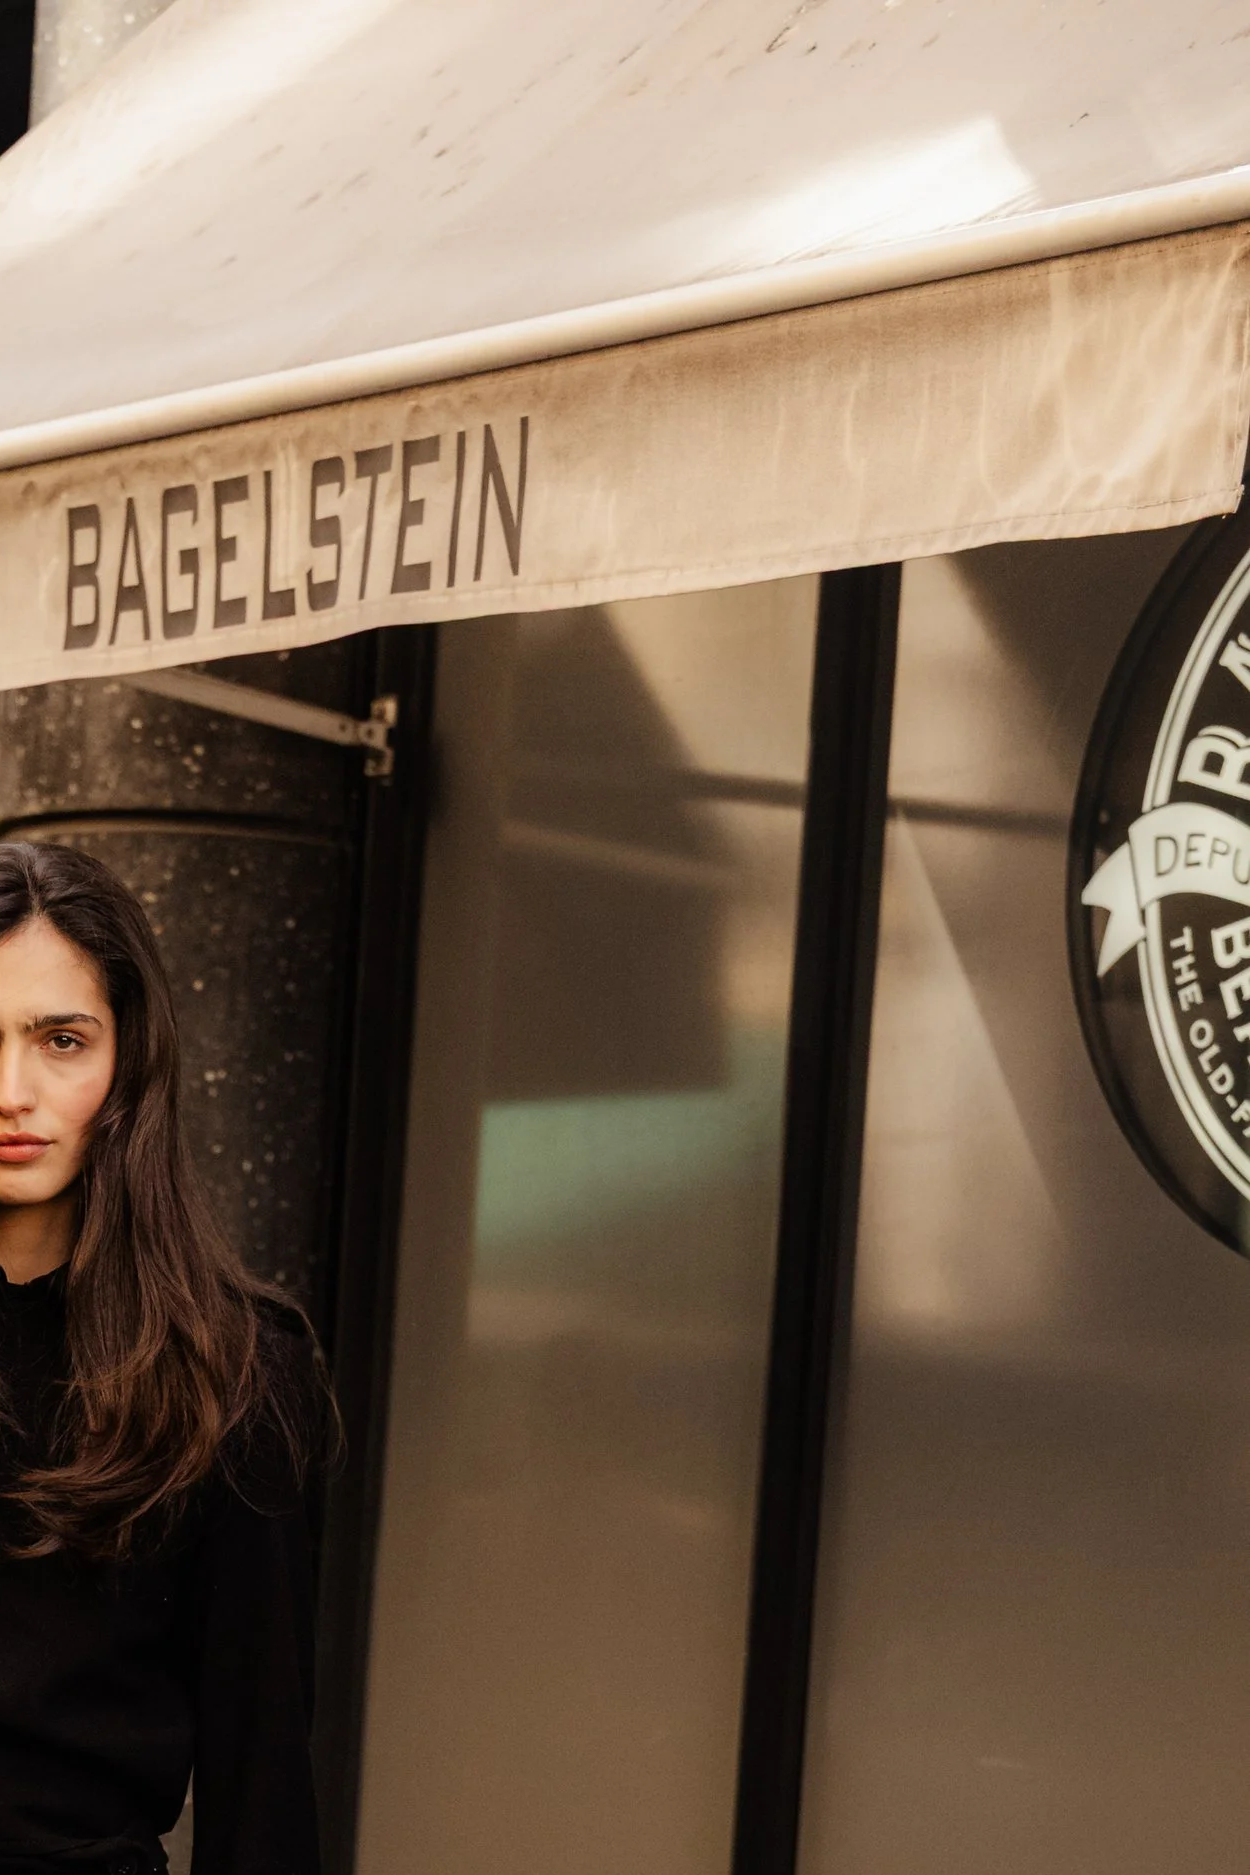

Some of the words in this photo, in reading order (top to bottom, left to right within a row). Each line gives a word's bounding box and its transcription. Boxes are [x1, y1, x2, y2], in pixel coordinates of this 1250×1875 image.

[63, 416, 529, 651] BAGELSTEIN
[1170, 925, 1203, 1012] THE
[1189, 1018, 1250, 1138] OLD-F
